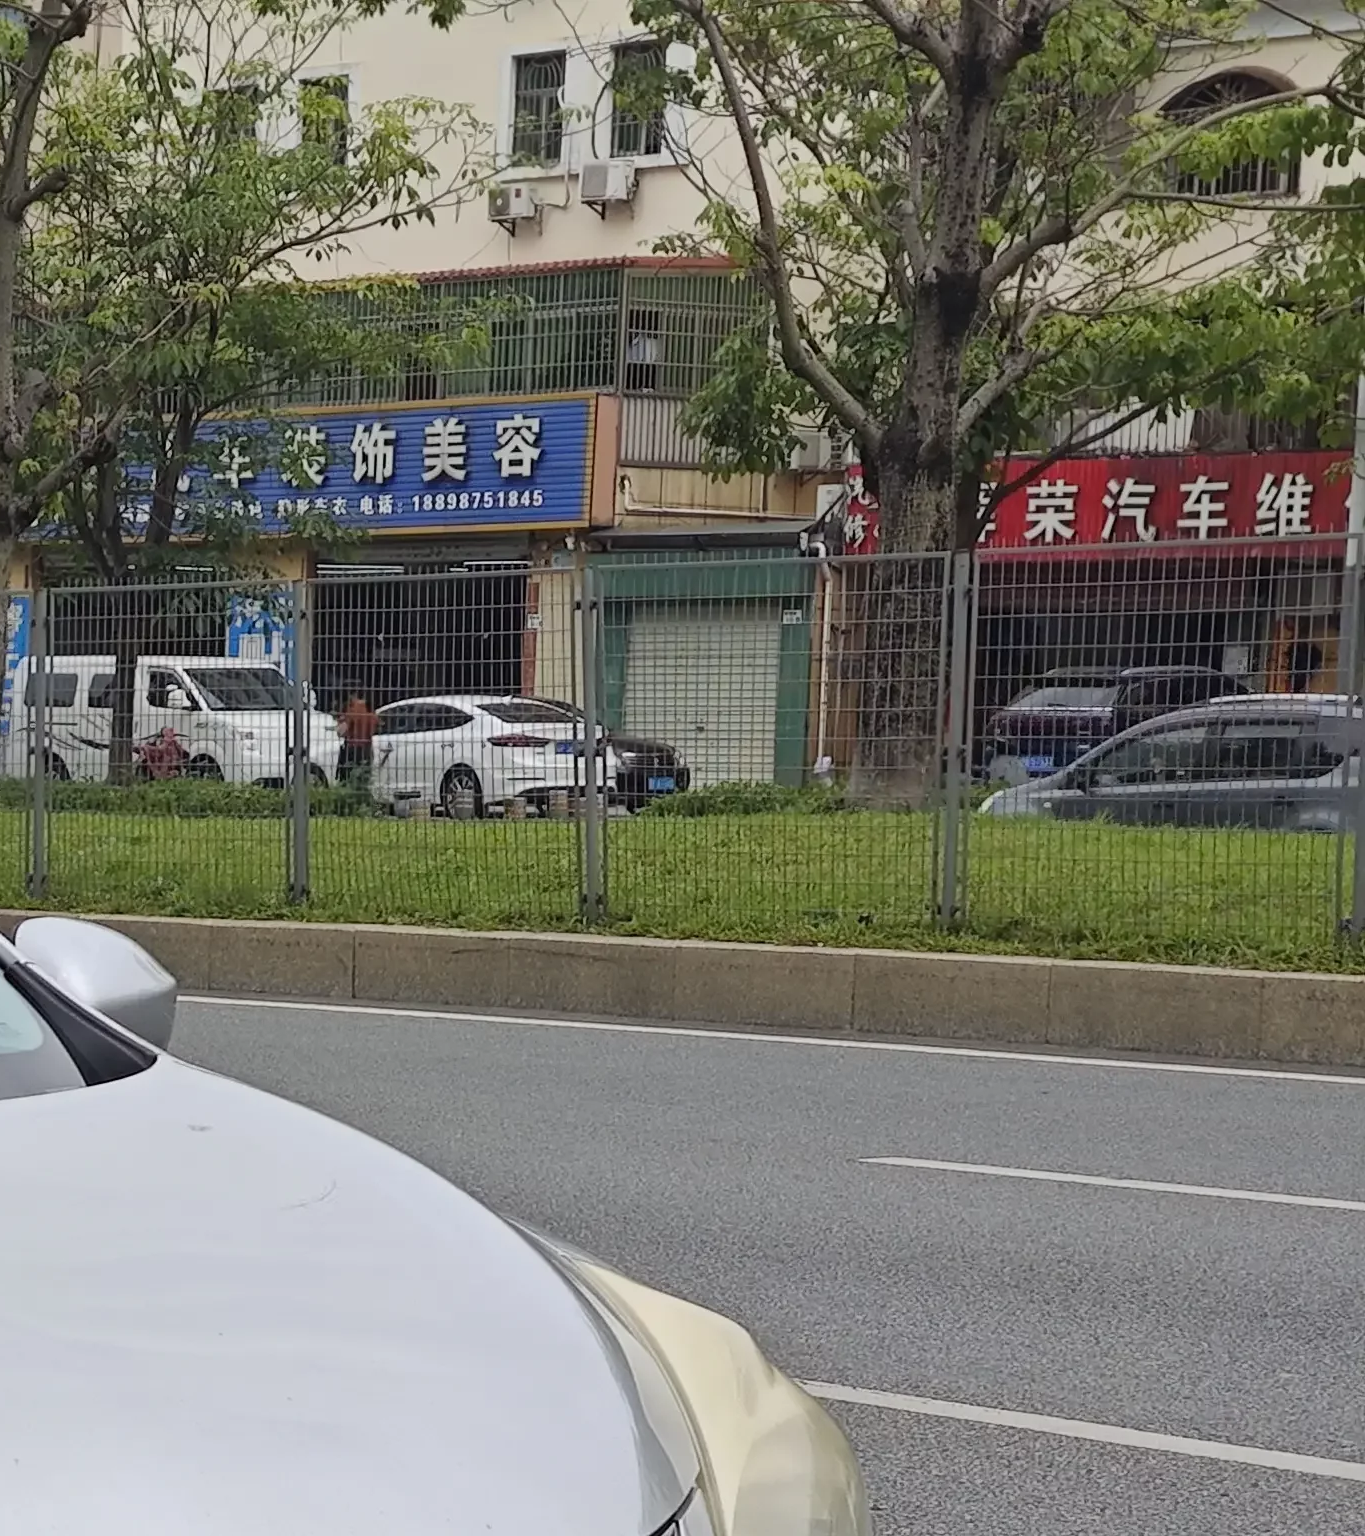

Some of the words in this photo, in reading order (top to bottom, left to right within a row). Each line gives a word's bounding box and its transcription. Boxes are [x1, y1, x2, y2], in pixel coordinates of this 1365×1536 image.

[151, 413, 542, 494] 车装饰美容
[846, 475, 879, 509] 洗
[976, 472, 1352, 543] 荣汽车维
[844, 513, 879, 549] 修
